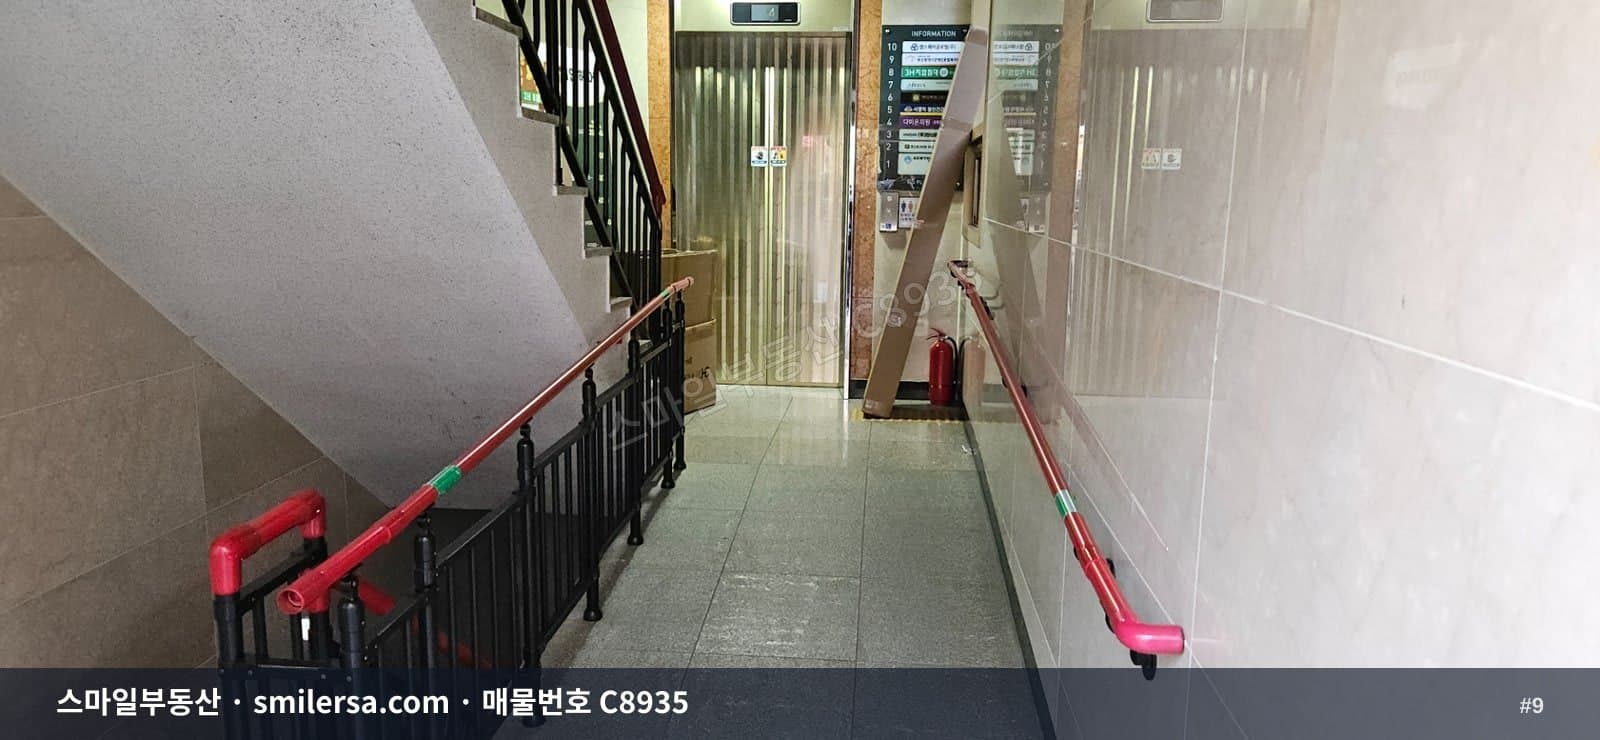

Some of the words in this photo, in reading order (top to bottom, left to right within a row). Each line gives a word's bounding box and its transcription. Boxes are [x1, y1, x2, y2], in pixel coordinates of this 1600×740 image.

[911, 30, 957, 38] INFORMATION
[887, 42, 898, 52] 10
[889, 55, 895, 64] 9
[888, 68, 895, 77] 8
[887, 80, 894, 89] 7
[887, 93, 894, 102] 6
[887, 105, 893, 114] 5
[886, 118, 893, 126] 4
[886, 130, 892, 139] 3
[885, 142, 892, 151] 2
[885, 160, 891, 168] 1
